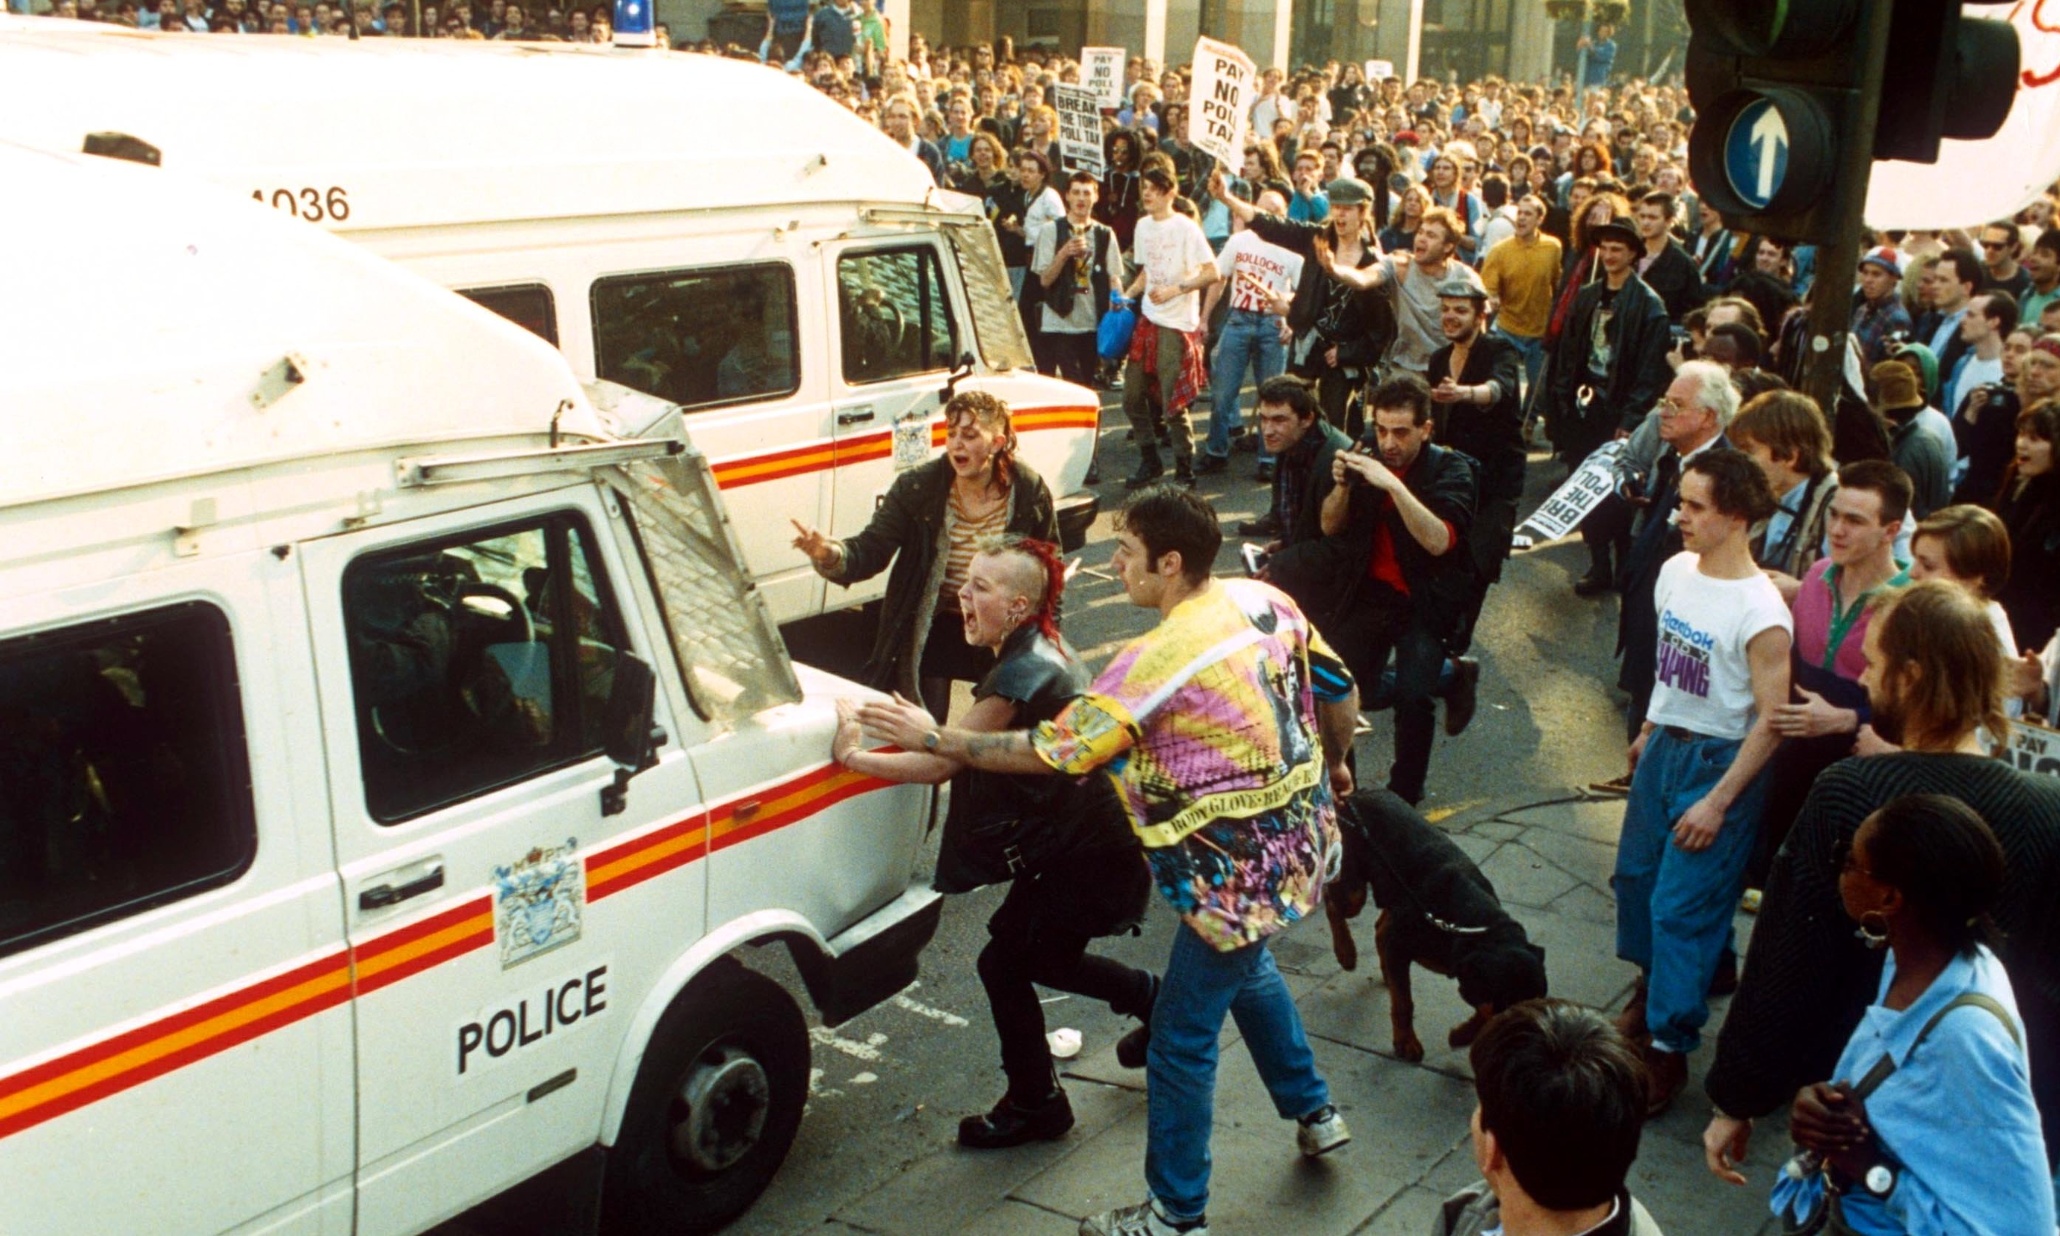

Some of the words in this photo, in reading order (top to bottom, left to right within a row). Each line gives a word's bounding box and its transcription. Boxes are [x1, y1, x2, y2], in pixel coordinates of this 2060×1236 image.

[1093, 55, 1113, 64] PAY
[1215, 58, 1244, 82] PAY
[1088, 79, 1113, 88] POLL
[1094, 66, 1111, 78] NO
[1214, 79, 1239, 108] NO
[1057, 95, 1097, 116] BREAK
[1203, 100, 1237, 129] POLL
[1060, 125, 1082, 142] POLL
[1085, 130, 1100, 145] TAX
[1206, 119, 1234, 144] TAX
[1236, 252, 1284, 275] BOLLOCKS
[1563, 486, 1595, 512] THE
[1662, 609, 1715, 651] Reebok
[2015, 733, 2048, 755] PAY
[458, 965, 607, 1074] POLICE
